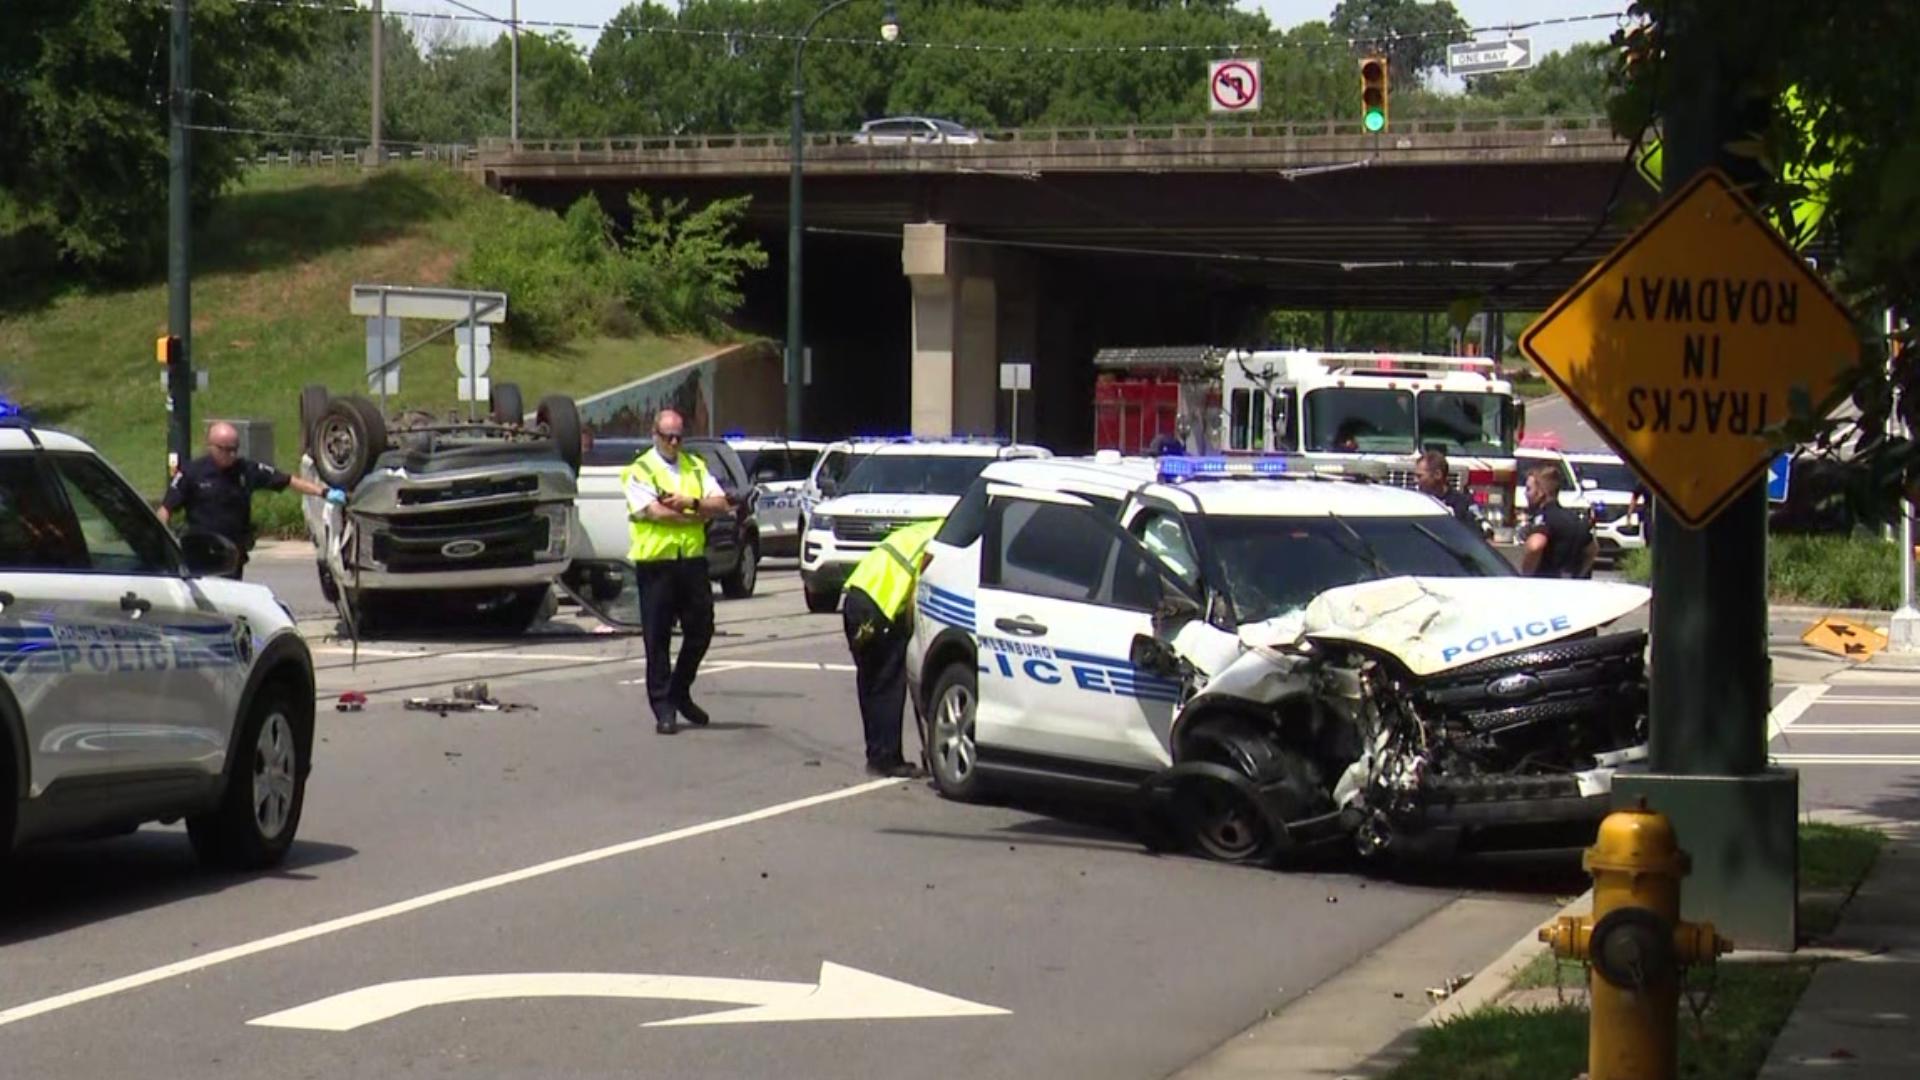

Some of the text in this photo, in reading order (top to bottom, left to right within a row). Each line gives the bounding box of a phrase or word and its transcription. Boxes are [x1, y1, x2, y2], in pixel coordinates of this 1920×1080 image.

[1459, 51, 1505, 64] ONE WAY
[1613, 276, 1798, 324] ROADWAY
[1683, 334, 1719, 379] IN
[1626, 388, 1768, 435] TRACKS
[766, 499, 802, 509] POLI
[62, 643, 192, 672] POLICE
[1441, 615, 1572, 662] POLICE
[979, 652, 1111, 693] ICE
